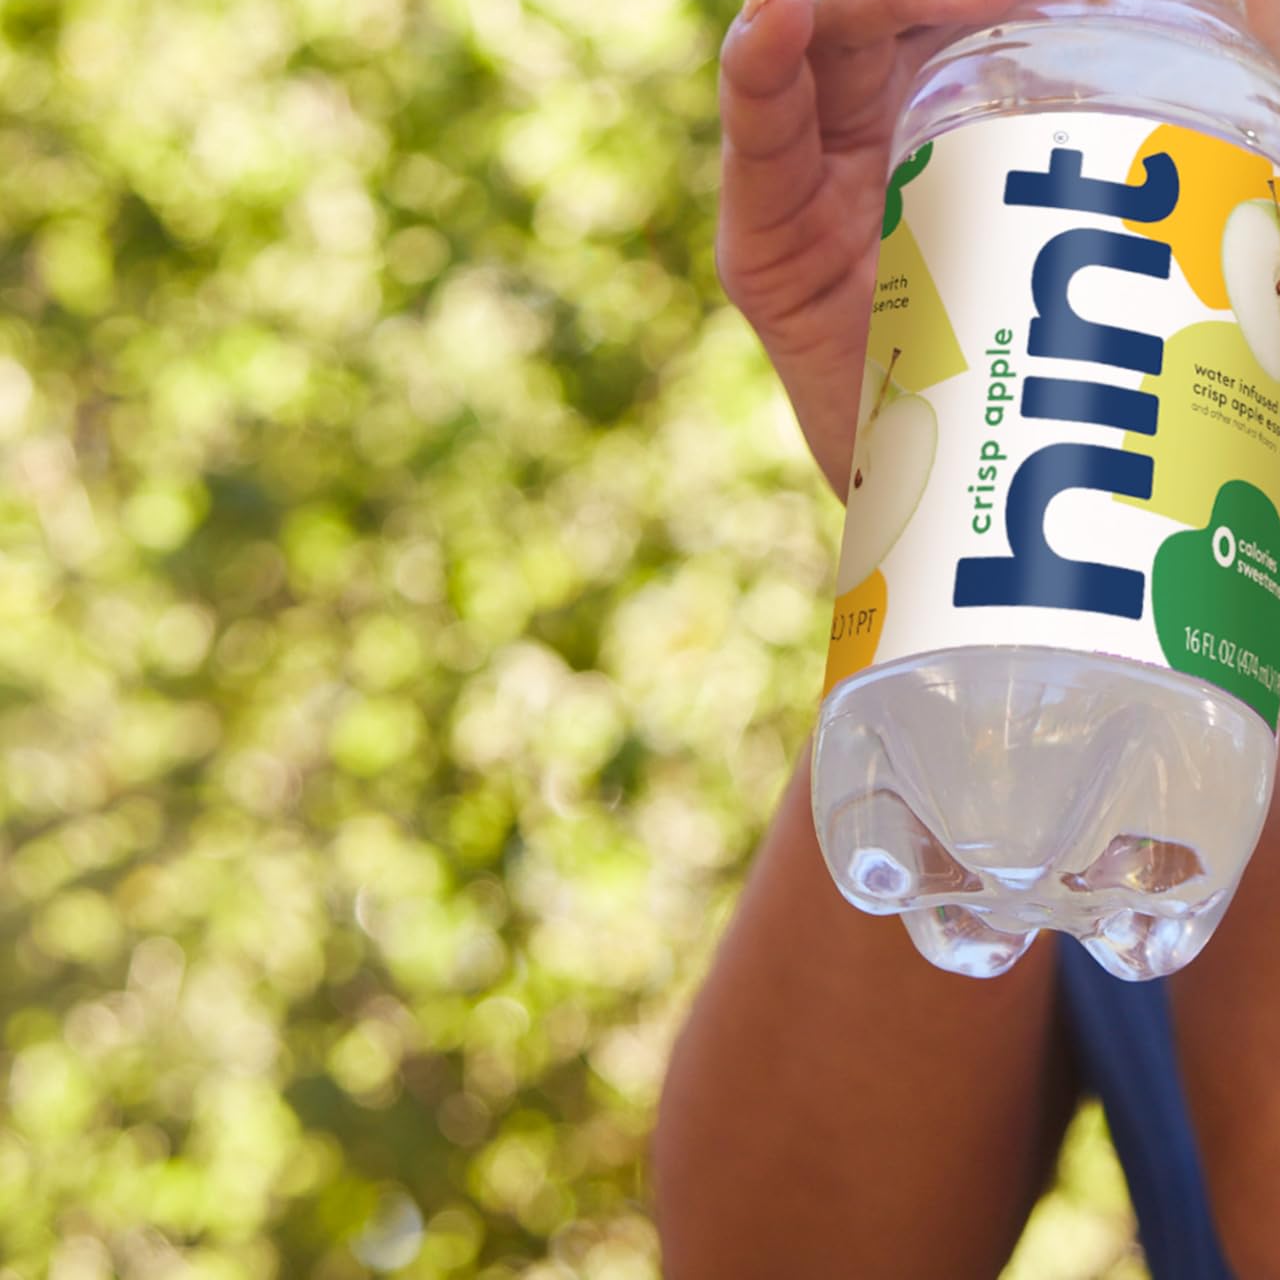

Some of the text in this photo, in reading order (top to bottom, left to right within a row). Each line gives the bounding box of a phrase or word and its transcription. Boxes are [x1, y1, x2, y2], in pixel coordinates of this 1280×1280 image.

[880, 274, 908, 292] with
[953, 147, 1180, 620] hint
[1193, 383, 1228, 408] crisp
[1231, 398, 1265, 425] apple
[1194, 363, 1236, 389] water
[1238, 379, 1280, 415] infused
[968, 328, 1017, 534] crisp apple
[1212, 526, 1278, 574] 0 calories
[856, 608, 877, 636] PT
[1184, 626, 1201, 653] 16
[1202, 632, 1217, 660] FL
[1218, 639, 1235, 668] OZ
